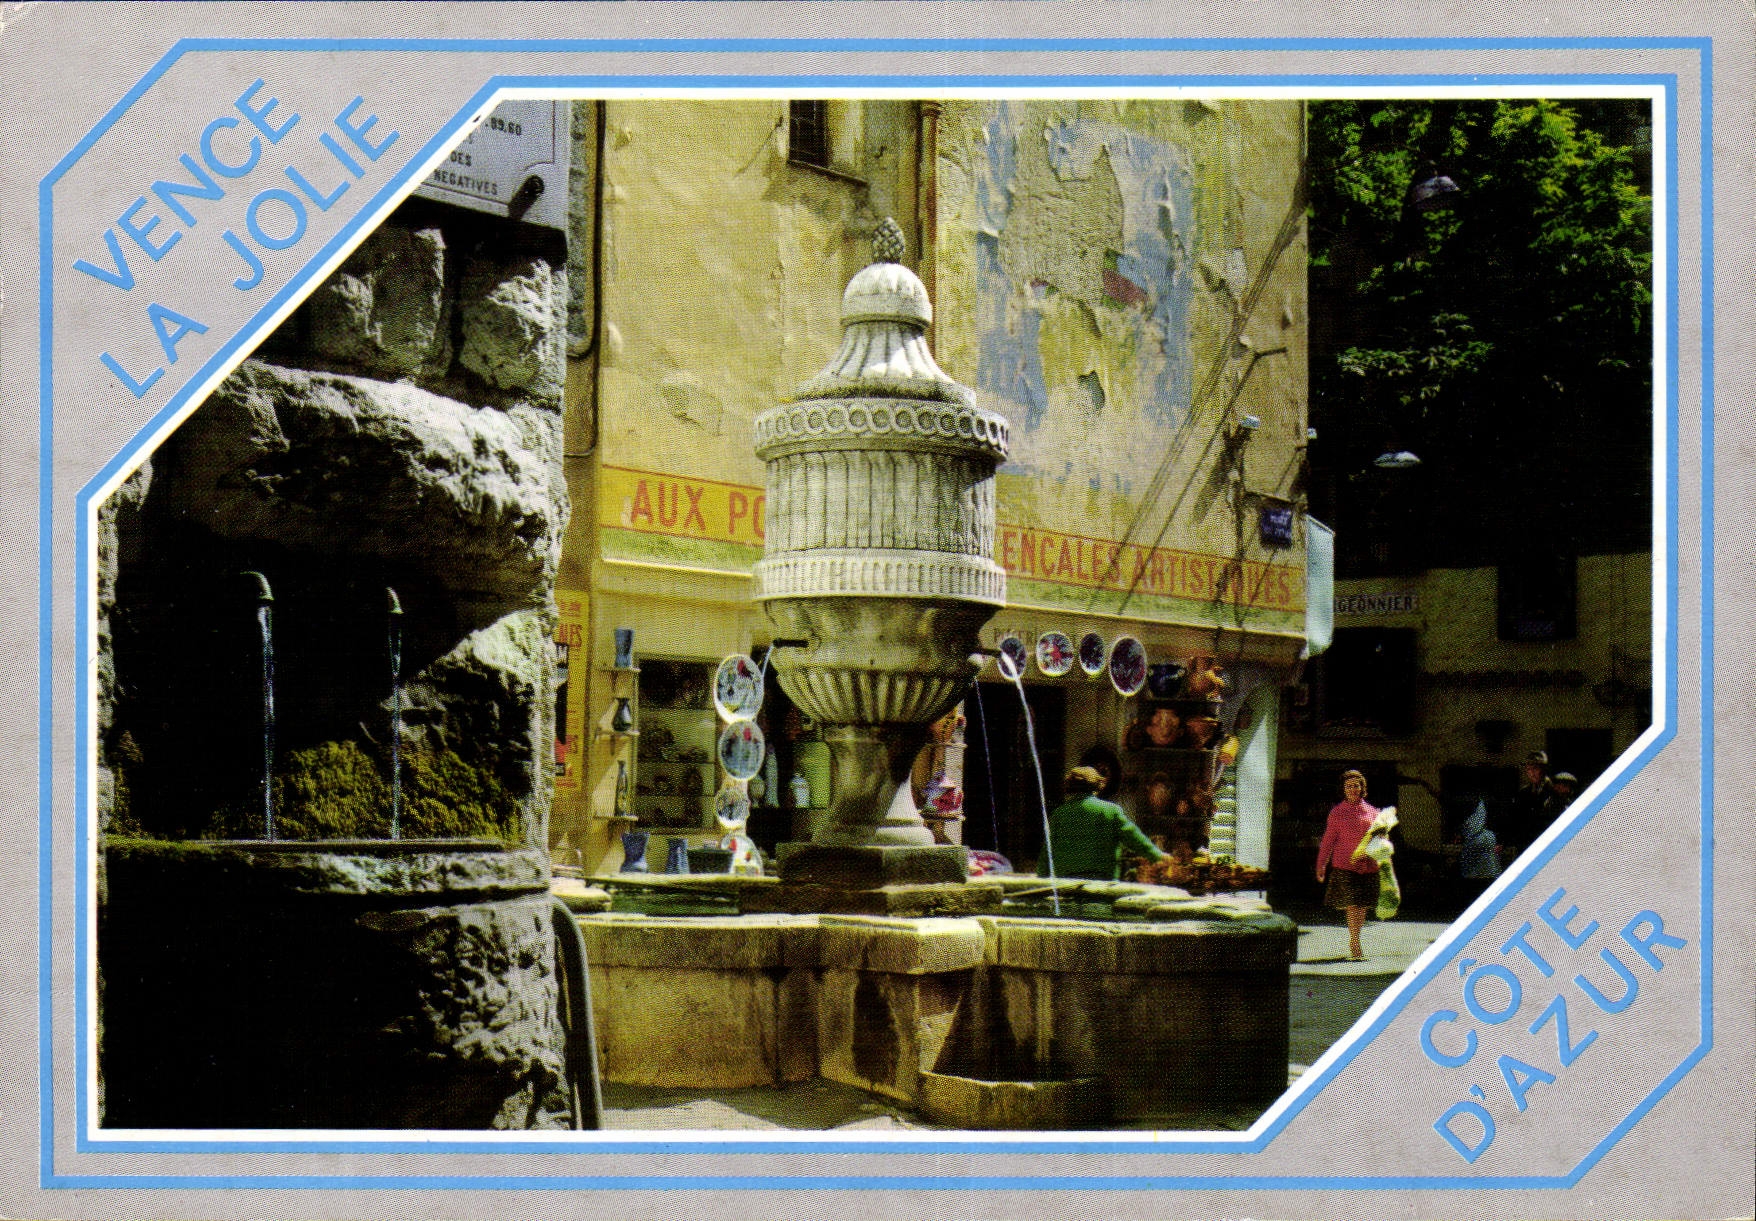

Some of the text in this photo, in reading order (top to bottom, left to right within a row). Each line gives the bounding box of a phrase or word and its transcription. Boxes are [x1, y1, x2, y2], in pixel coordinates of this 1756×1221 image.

[433, 168, 499, 196] NEGATIVES
[630, 479, 706, 532] AUX
[1130, 549, 1291, 606] ARTISTIQUES
